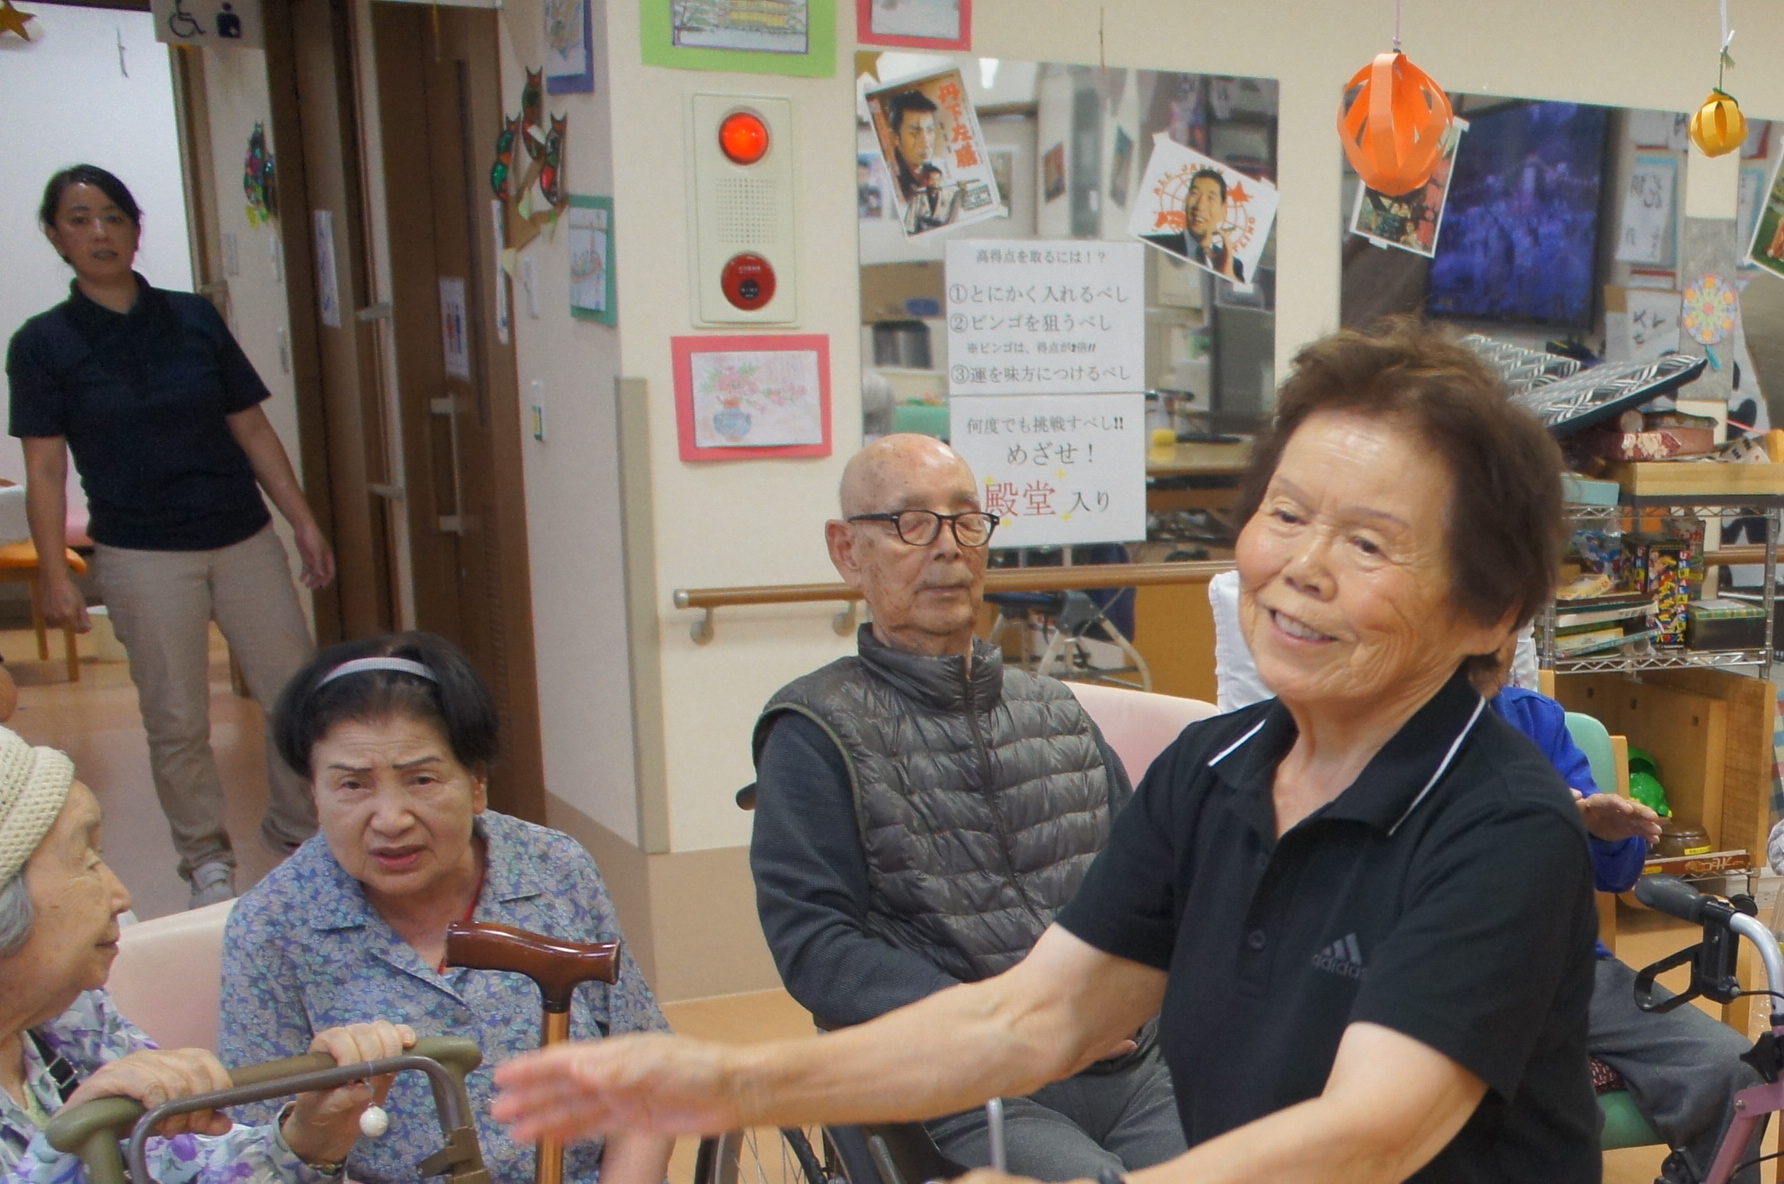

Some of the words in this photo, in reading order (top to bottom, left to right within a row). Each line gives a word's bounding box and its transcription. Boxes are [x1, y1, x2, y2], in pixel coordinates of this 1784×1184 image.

[950, 284, 1129, 304] ①とにかく入れるべし
[951, 313, 1112, 333] ②ビンゴを狙うべし
[951, 364, 1131, 384] ③運を味方につけるべし
[1007, 441, 1094, 466] めざせ！
